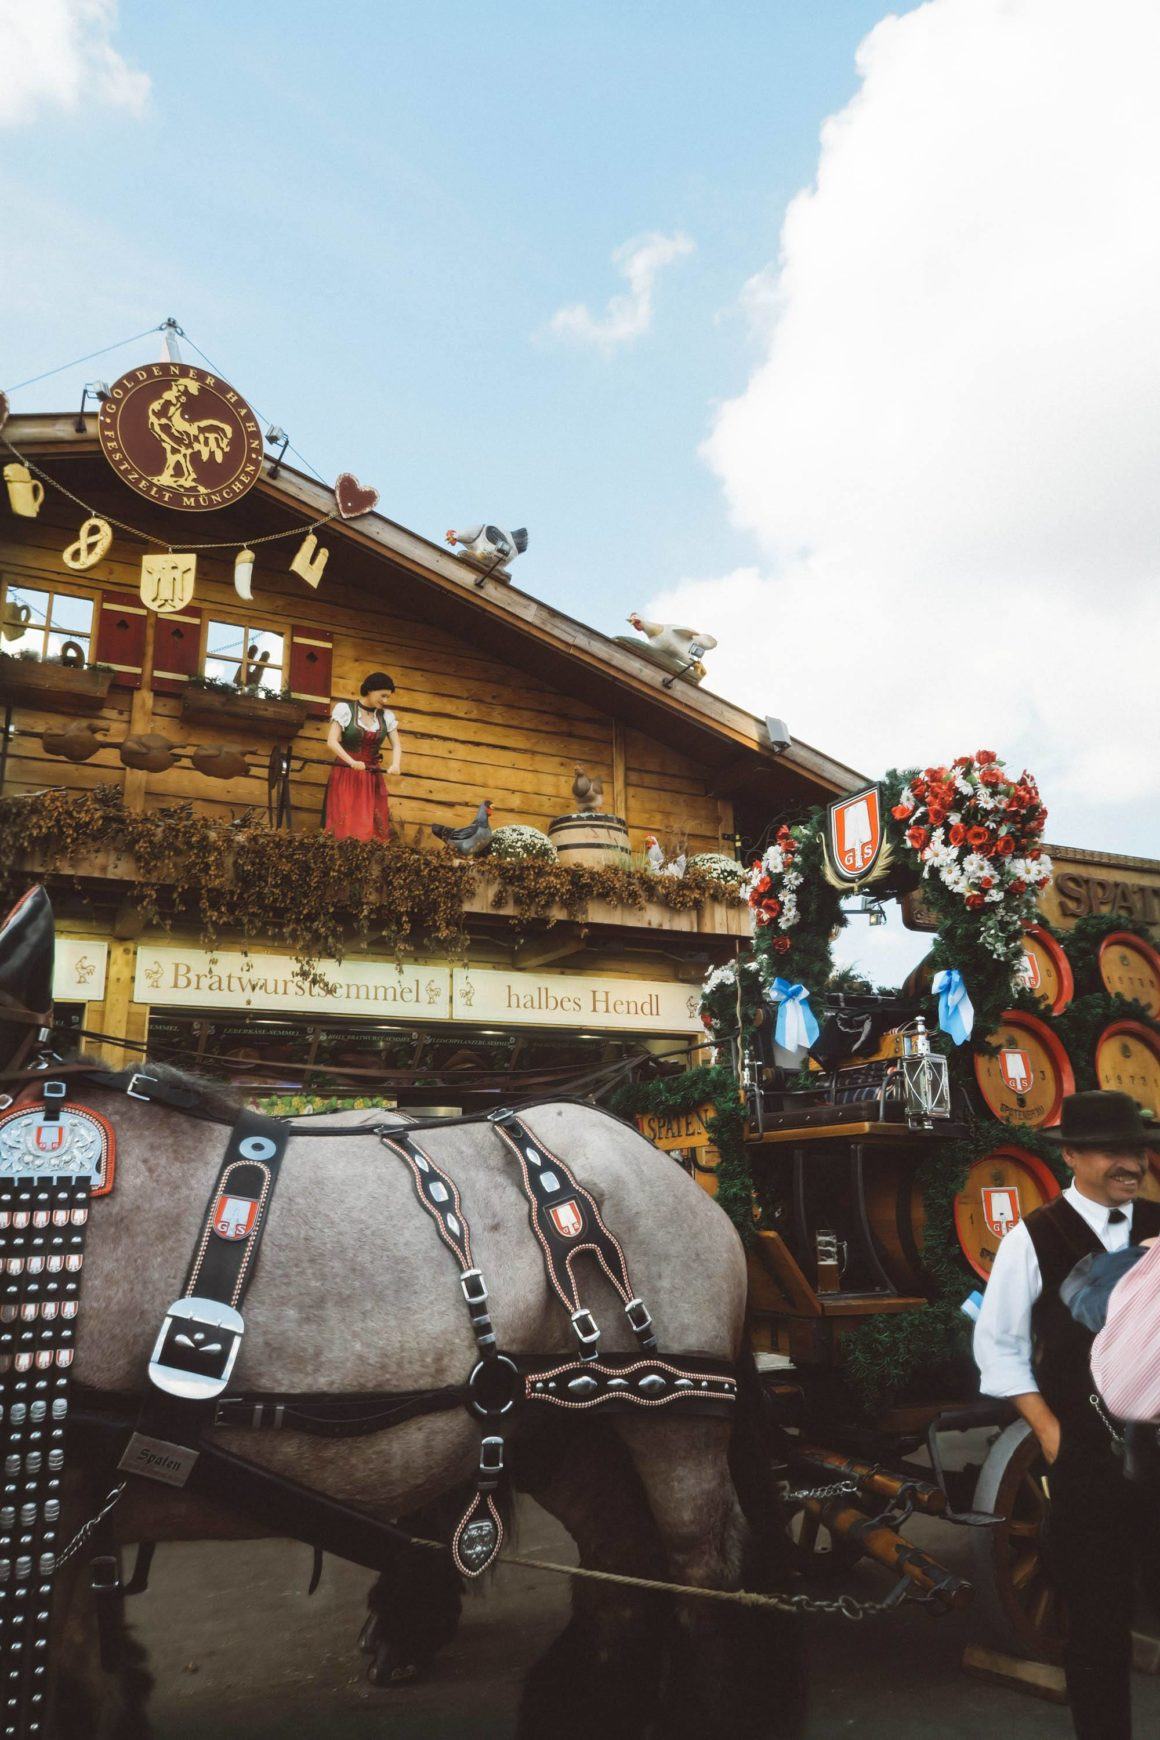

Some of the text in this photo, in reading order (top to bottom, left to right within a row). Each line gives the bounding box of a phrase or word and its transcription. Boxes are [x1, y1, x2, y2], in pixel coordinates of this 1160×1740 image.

[105, 365, 261, 449] GOLDENER HAHN
[104, 430, 256, 507] FESTZELT MÜNCHEN
[170, 962, 421, 1003] Bratwurstsemmel
[506, 985, 661, 1016] halbes Hendl
[138, 1448, 182, 1472] Spaten
